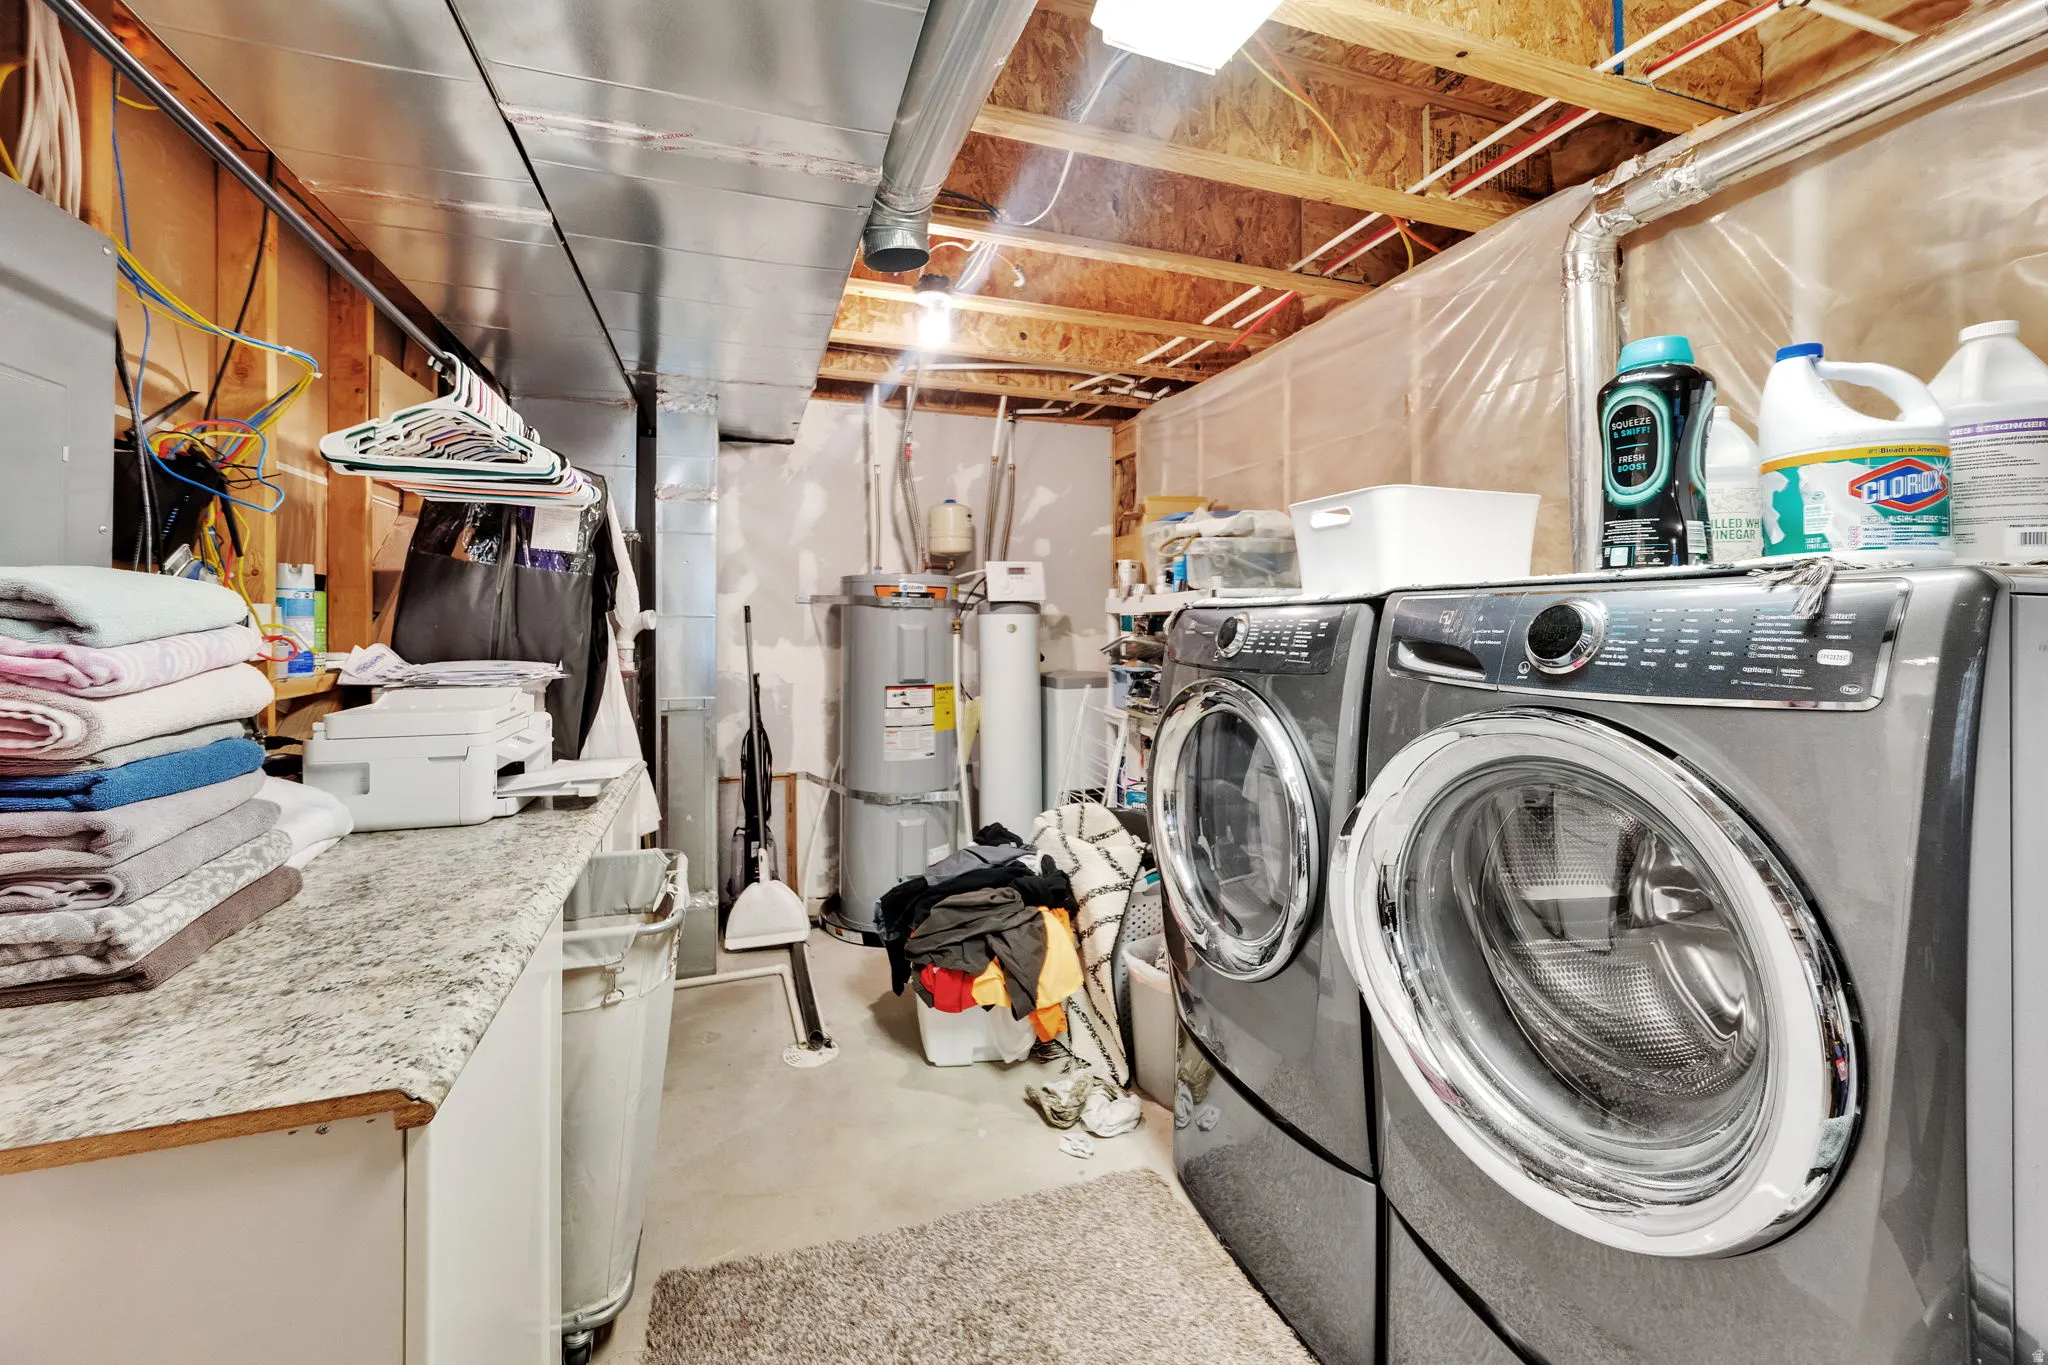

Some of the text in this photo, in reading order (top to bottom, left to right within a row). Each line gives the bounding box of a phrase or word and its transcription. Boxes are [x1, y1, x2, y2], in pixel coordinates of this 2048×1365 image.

[1611, 417, 1651, 430] SQUEEZE
[1976, 421, 2046, 433] STRONGER
[1621, 426, 1651, 437] SNIFF!
[1618, 454, 1645, 463] FRESH
[1617, 463, 1648, 473] BOOST
[1861, 469, 1944, 504] CLOROX
[1742, 666, 1773, 674] options
